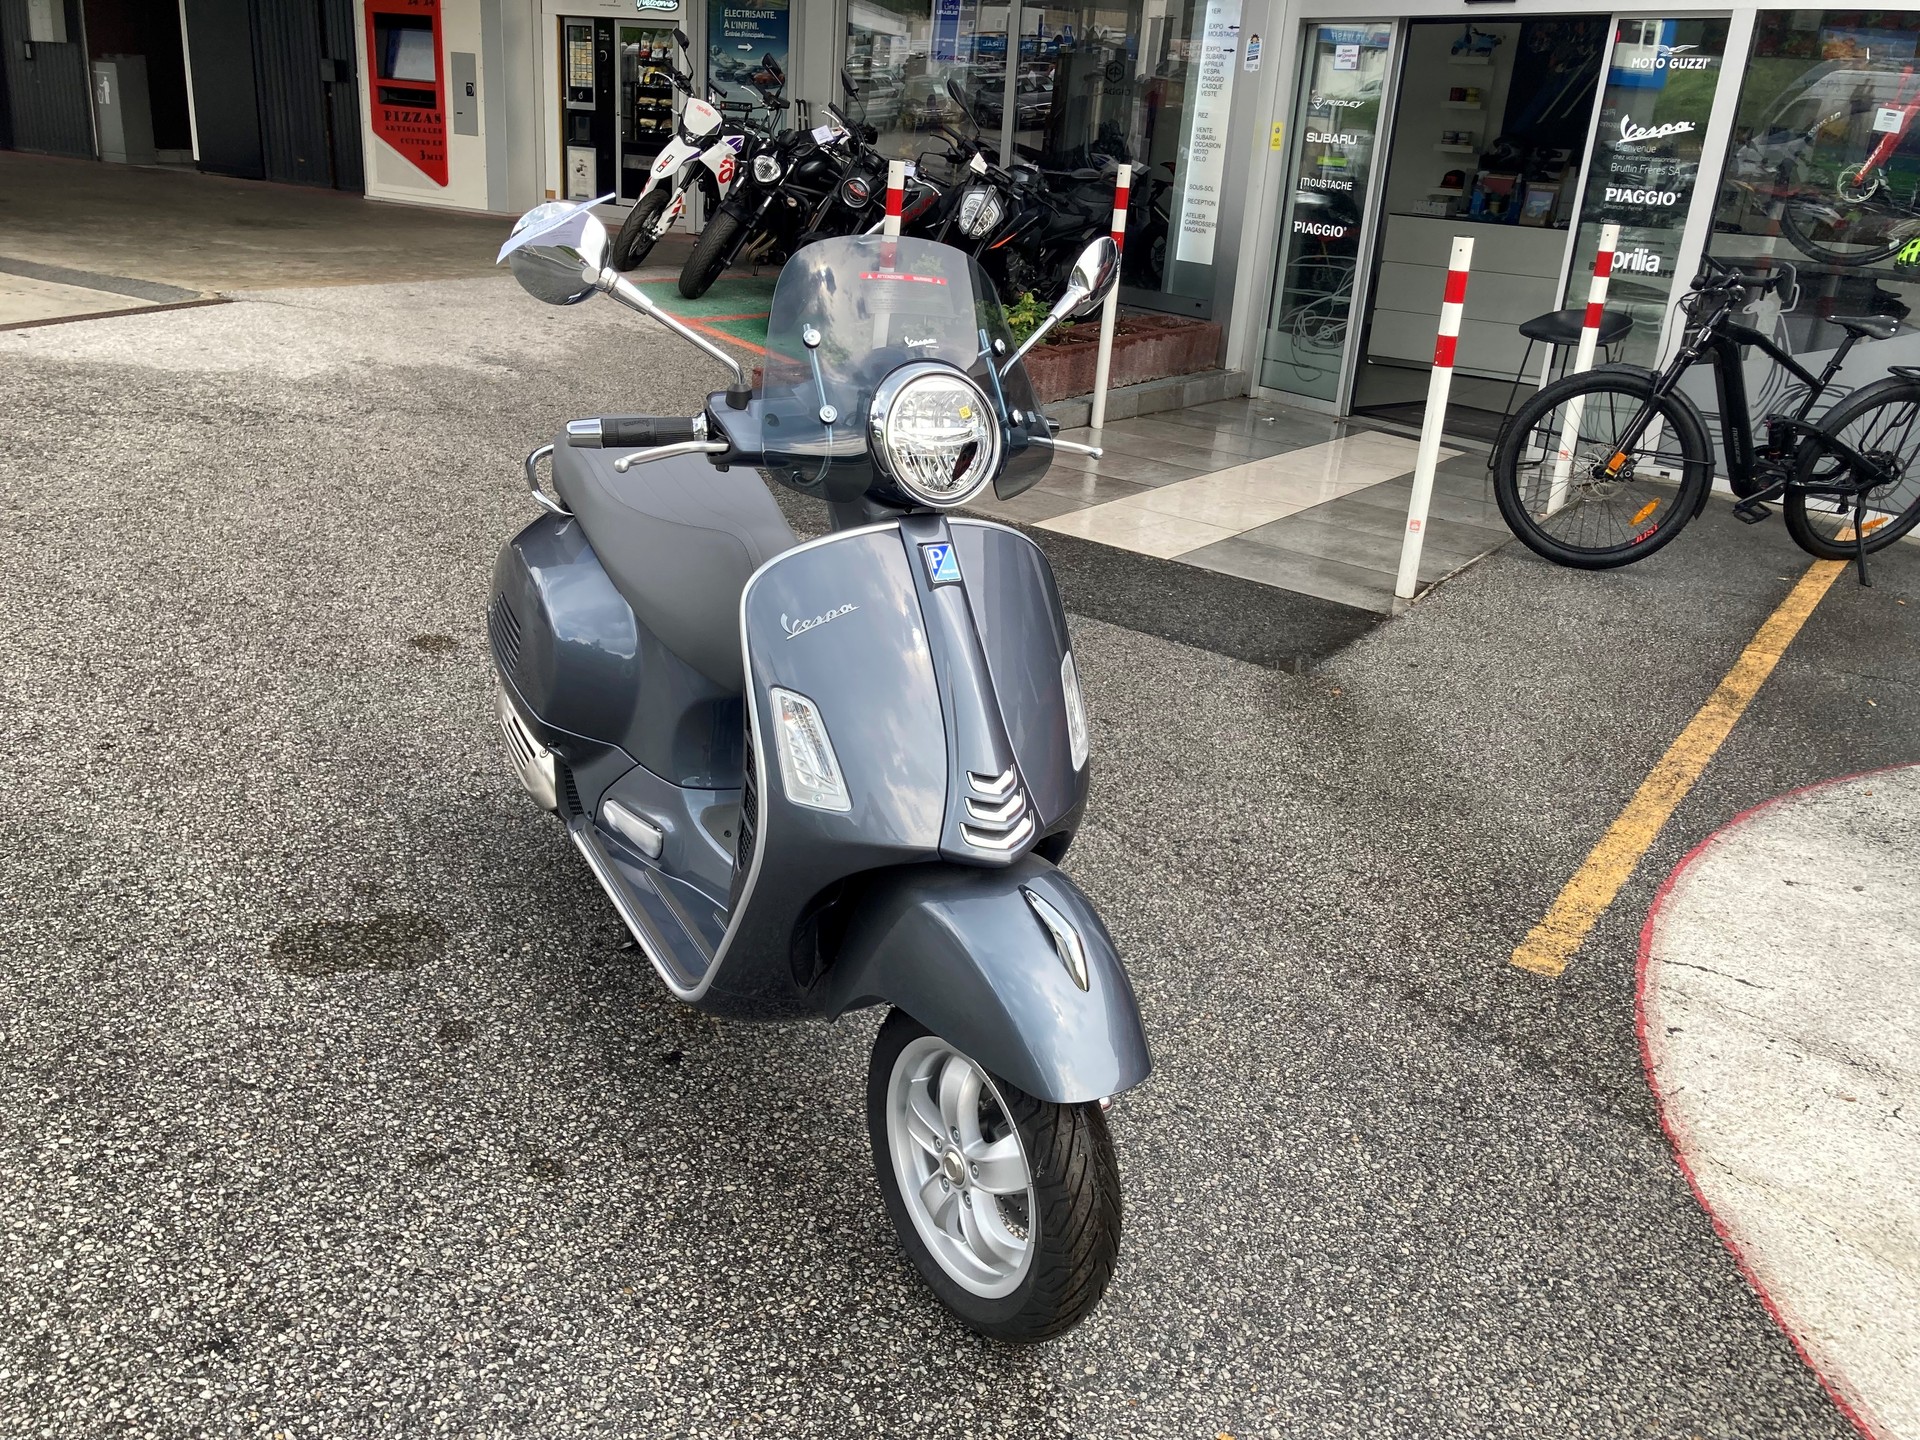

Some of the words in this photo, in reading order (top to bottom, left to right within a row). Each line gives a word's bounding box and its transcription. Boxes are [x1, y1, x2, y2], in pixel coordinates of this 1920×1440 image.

[724, 8, 777, 20] ÉLECTRISANTE.
[724, 19, 730, 28] À
[741, 31, 764, 39] Principale
[1631, 57, 1666, 69] MOTO
[1669, 57, 1708, 70] GUZZI
[1103, 87, 1131, 97] AGGIO
[1324, 99, 1365, 109] RIDLEY
[384, 110, 442, 125] PIZZAS
[1198, 111, 1208, 119] REZ
[385, 125, 442, 134] ARTISANALES
[1617, 114, 1696, 143] Vespa
[1306, 132, 1357, 145] SUBARU
[1194, 141, 1221, 149] OCCASION
[1614, 142, 1657, 153] Bienvenue
[1668, 166, 1681, 176] SA
[1189, 184, 1214, 192] SOUS-SOL
[1604, 187, 1679, 206] PIAGGIO
[1187, 198, 1216, 206] RECEPTION
[1184, 226, 1206, 234] MAGASIN
[1294, 221, 1346, 237] PIAGGIO
[1611, 248, 1661, 273] prilia
[904, 336, 937, 348] Vespa
[780, 603, 860, 641] Vespa
